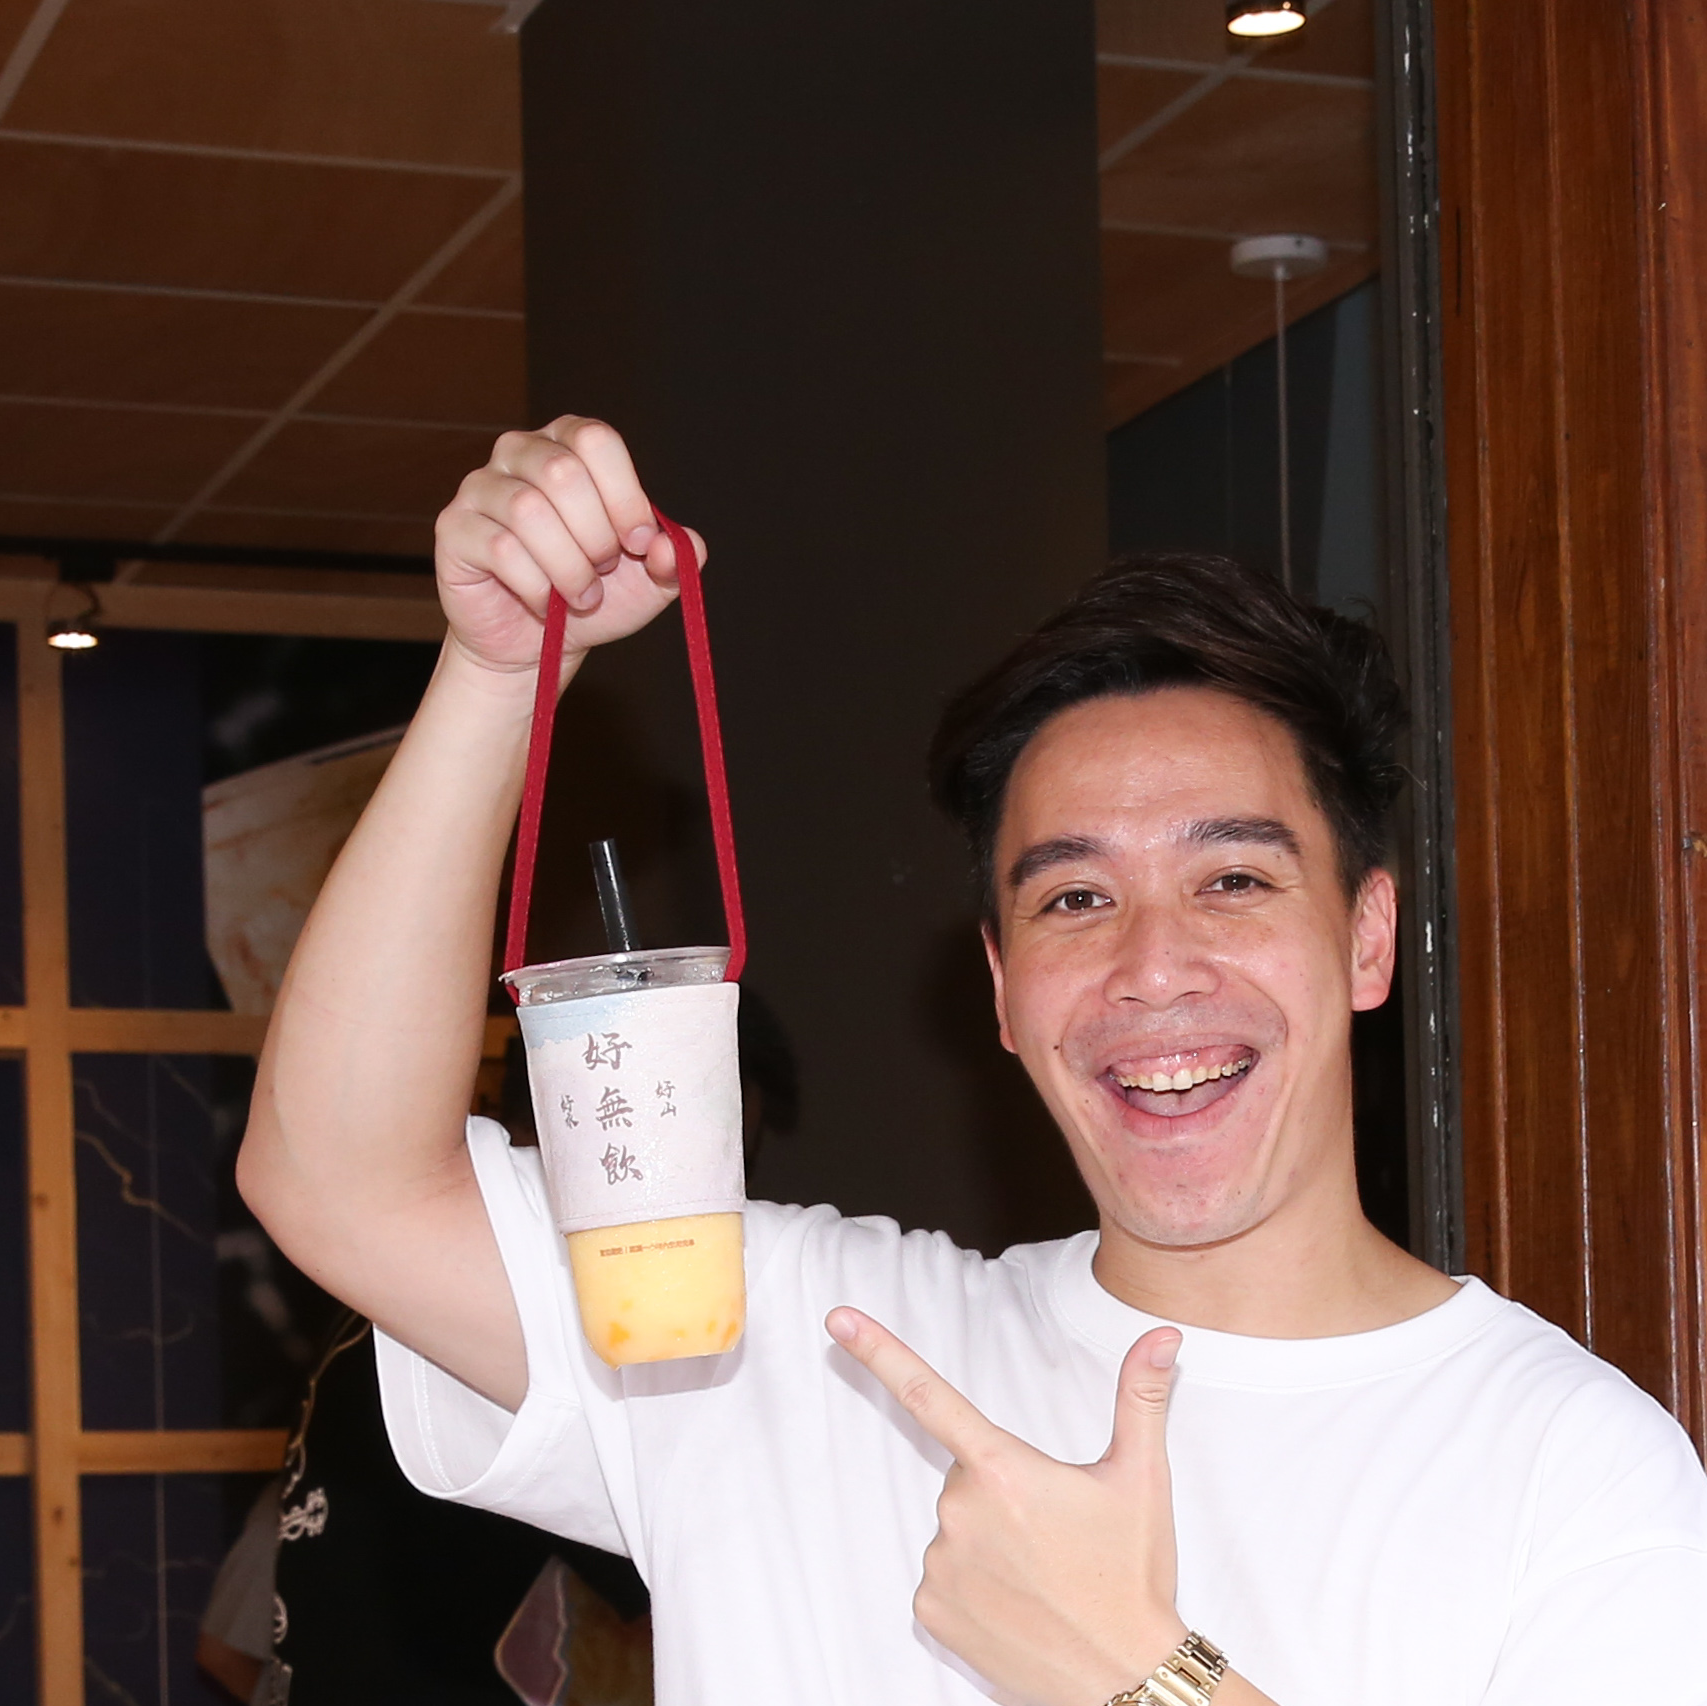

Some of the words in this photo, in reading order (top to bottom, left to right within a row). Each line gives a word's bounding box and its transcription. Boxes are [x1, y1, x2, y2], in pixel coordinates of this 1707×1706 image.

[581, 1032, 644, 1186] 好無飲
[655, 1080, 678, 1118] 好山
